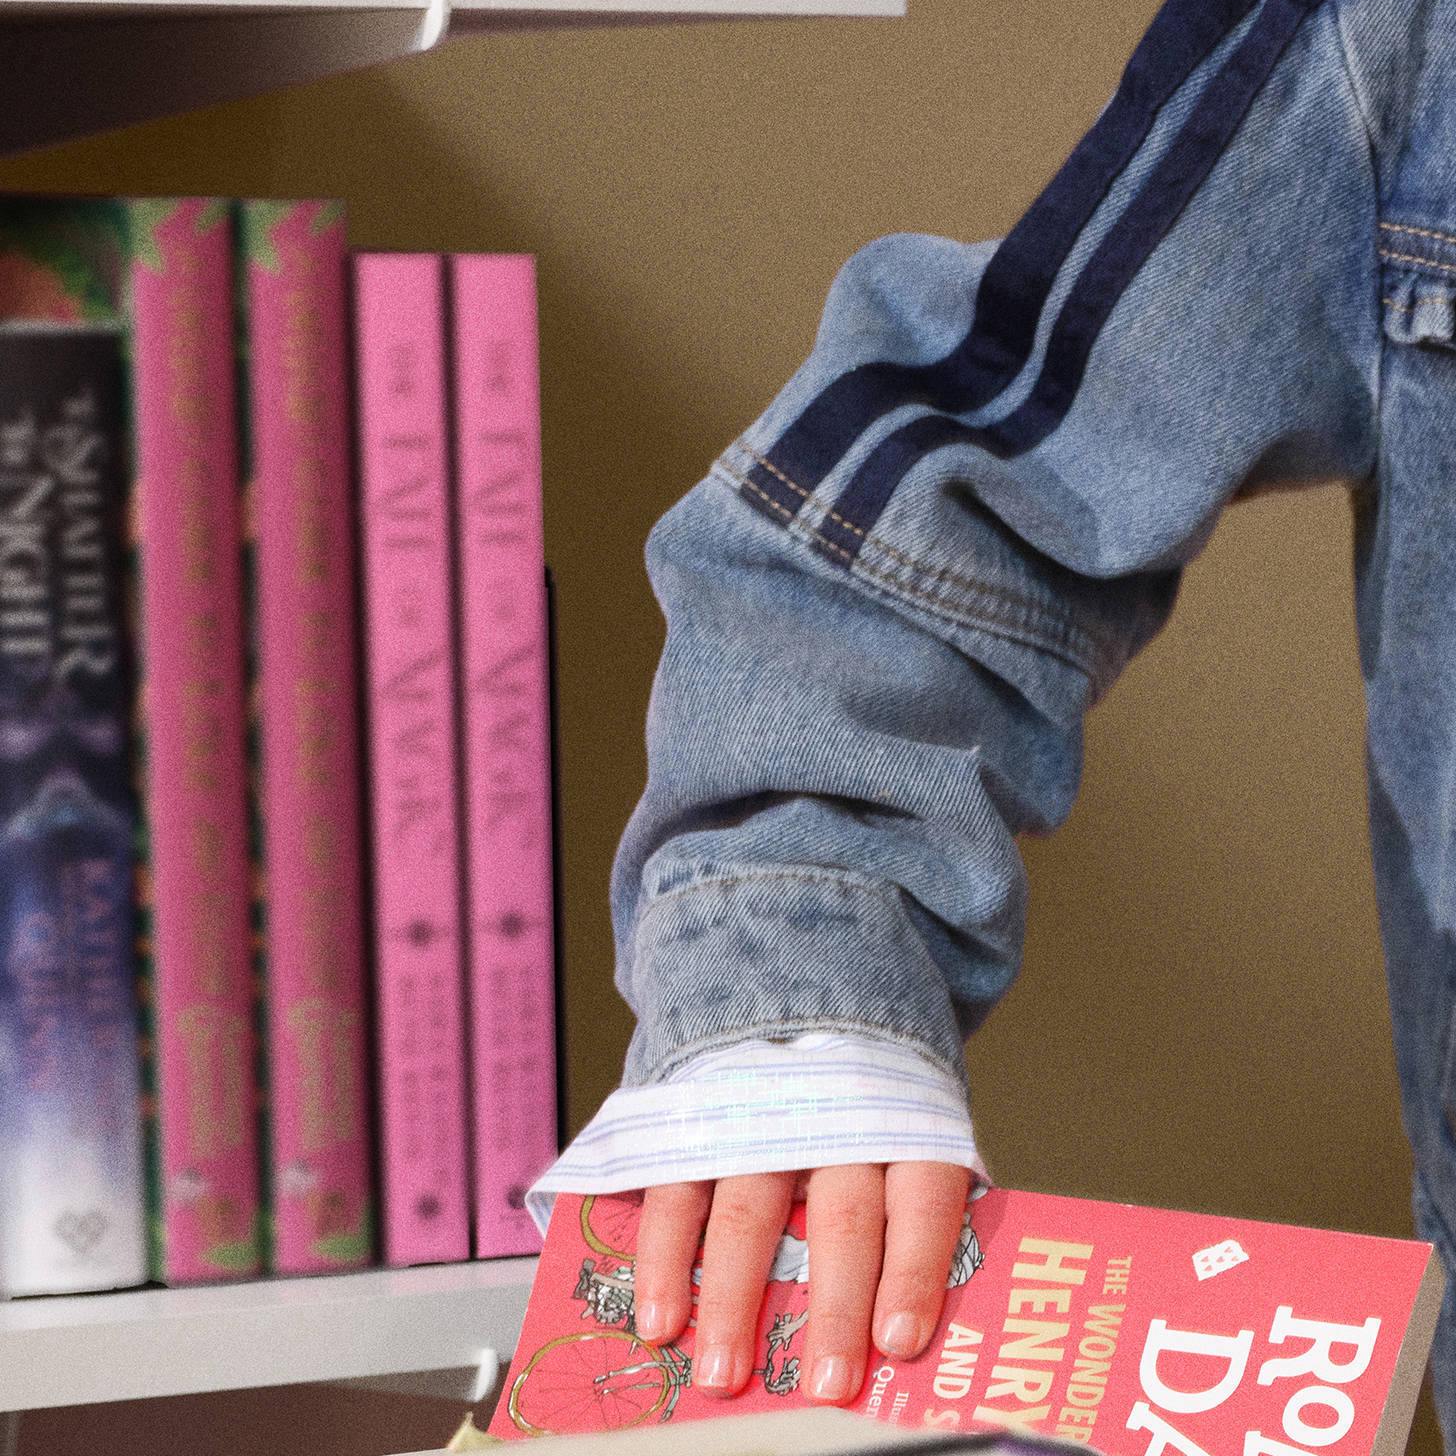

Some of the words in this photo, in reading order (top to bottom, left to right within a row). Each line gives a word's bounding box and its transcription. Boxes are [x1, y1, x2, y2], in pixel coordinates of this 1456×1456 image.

[1102, 1255, 1132, 1296] THE
[932, 1322, 985, 1400] AND
[972, 1237, 1095, 1433] HENRY
